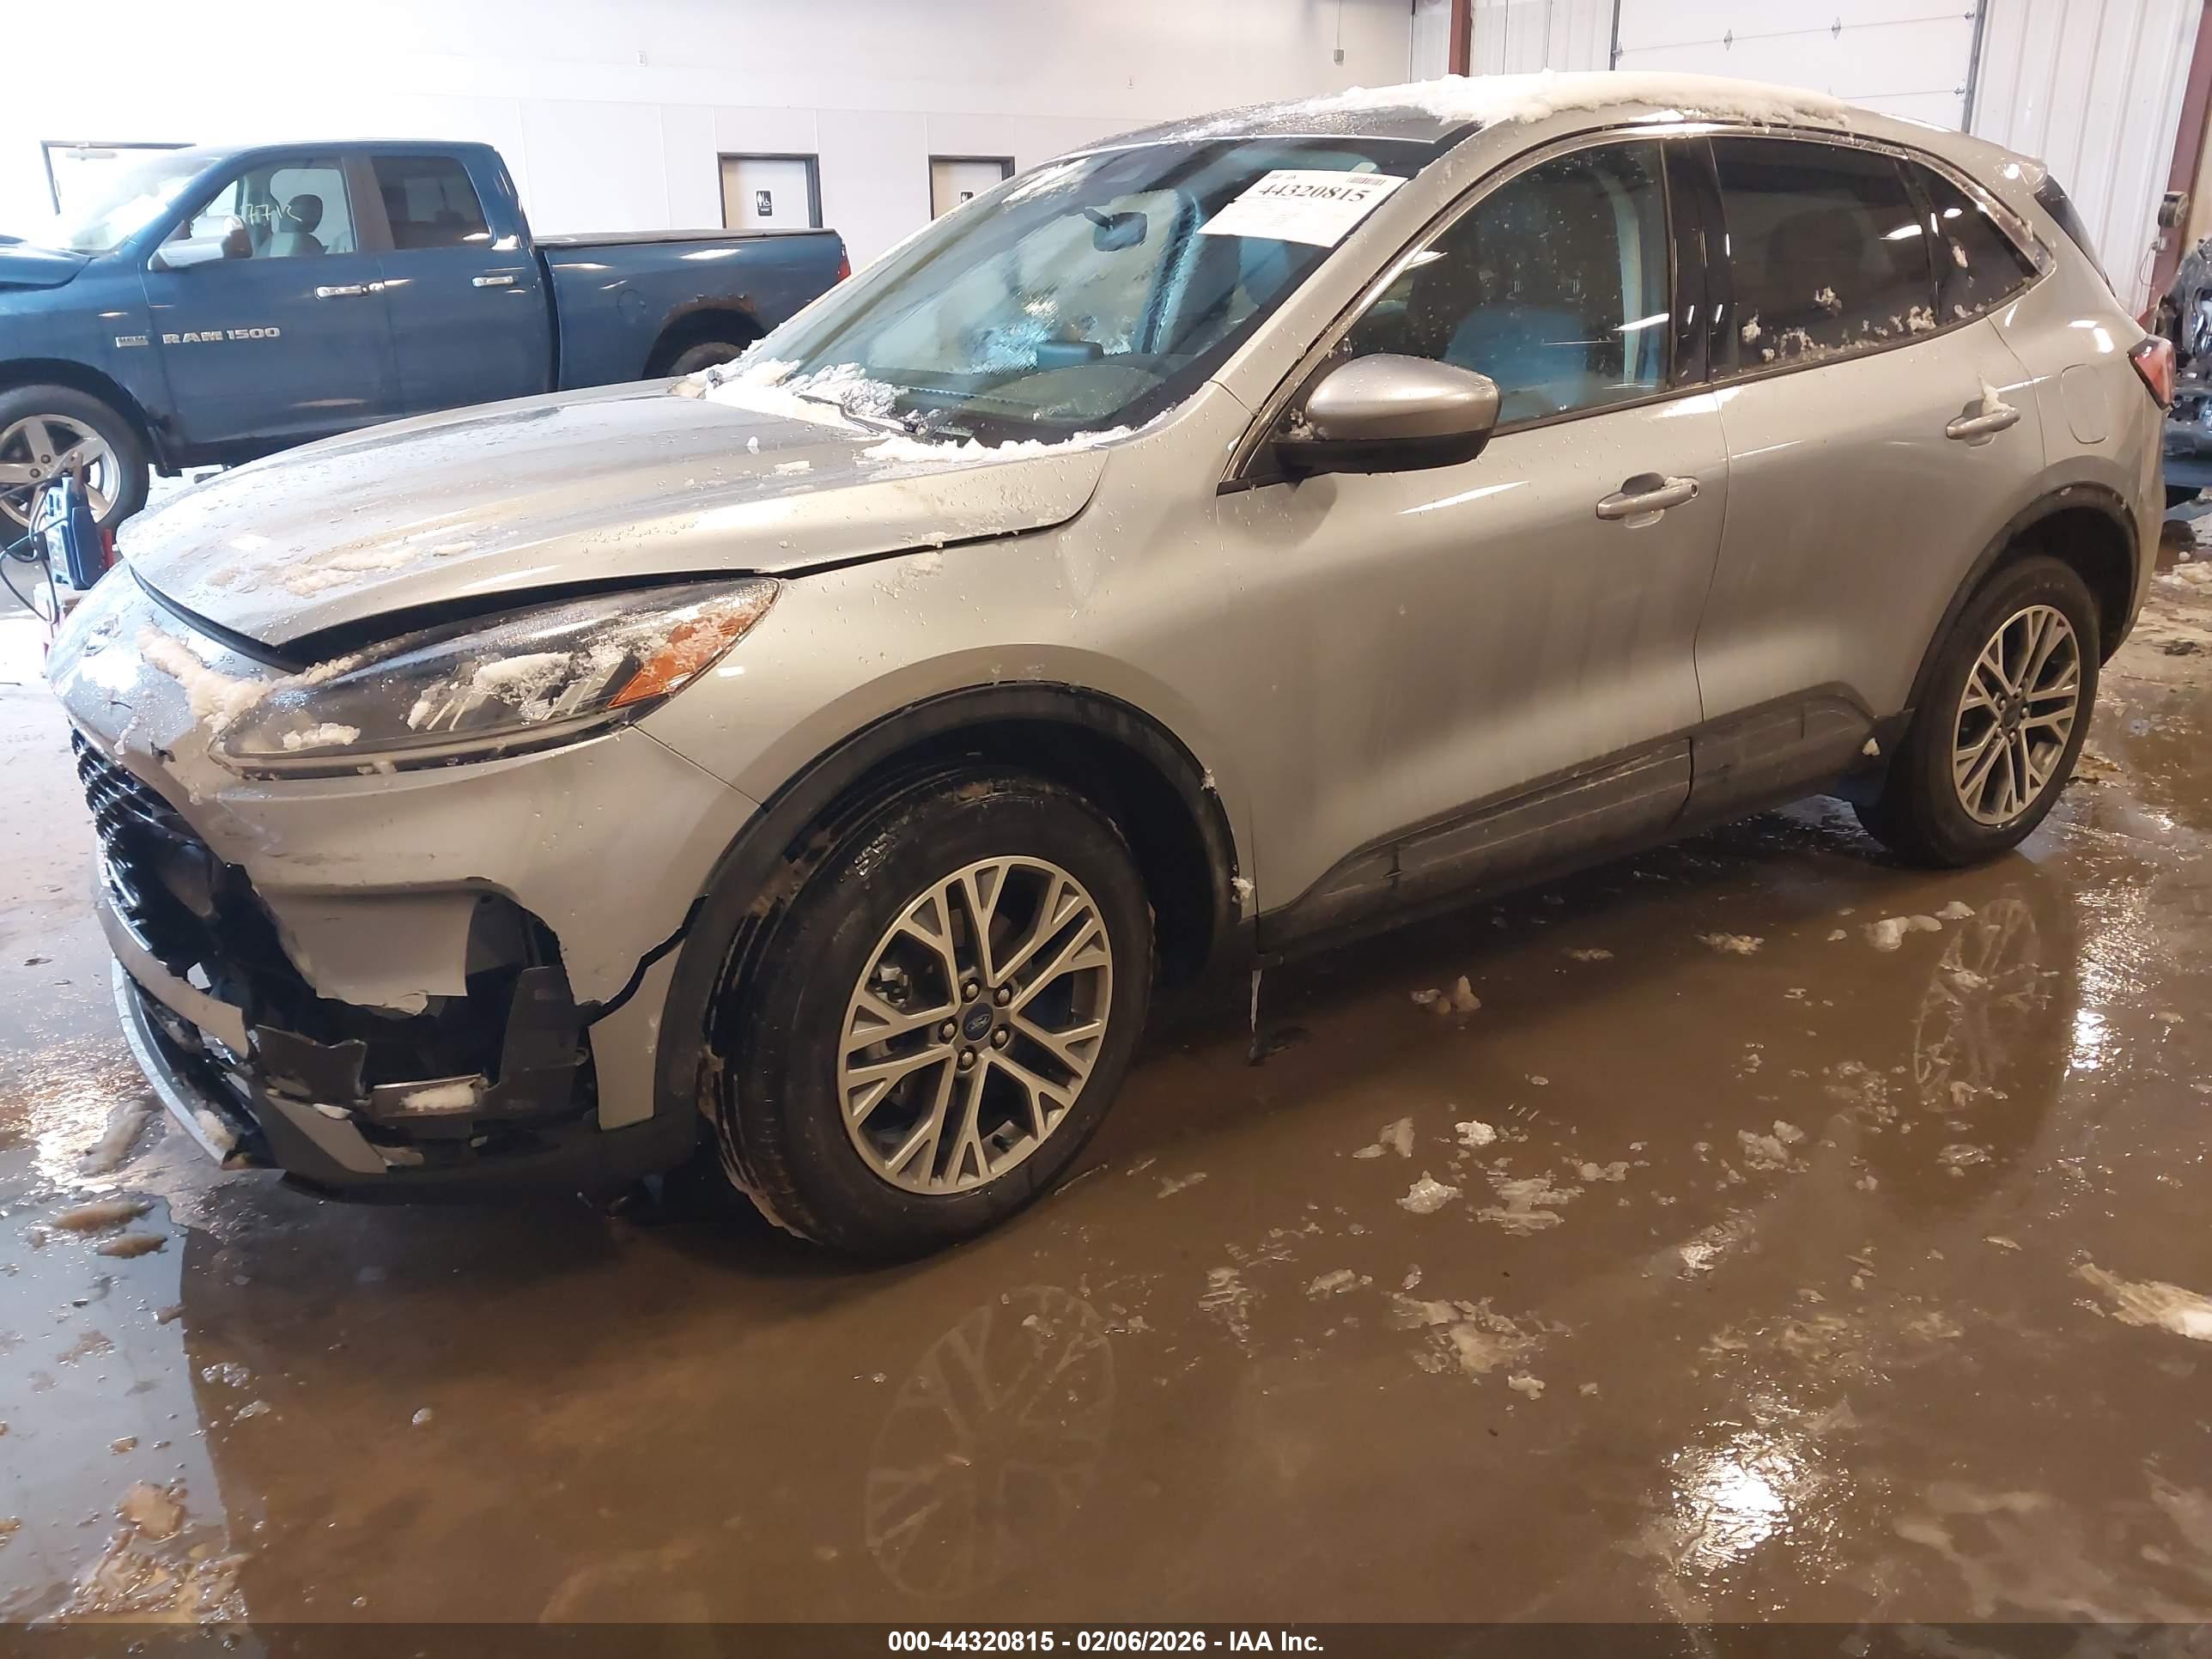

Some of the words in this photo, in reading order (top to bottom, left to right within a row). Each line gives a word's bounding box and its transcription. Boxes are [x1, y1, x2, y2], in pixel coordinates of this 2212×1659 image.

[1258, 183, 1372, 203] 44320815
[161, 331, 223, 345] RAM
[226, 327, 281, 341] 1500
